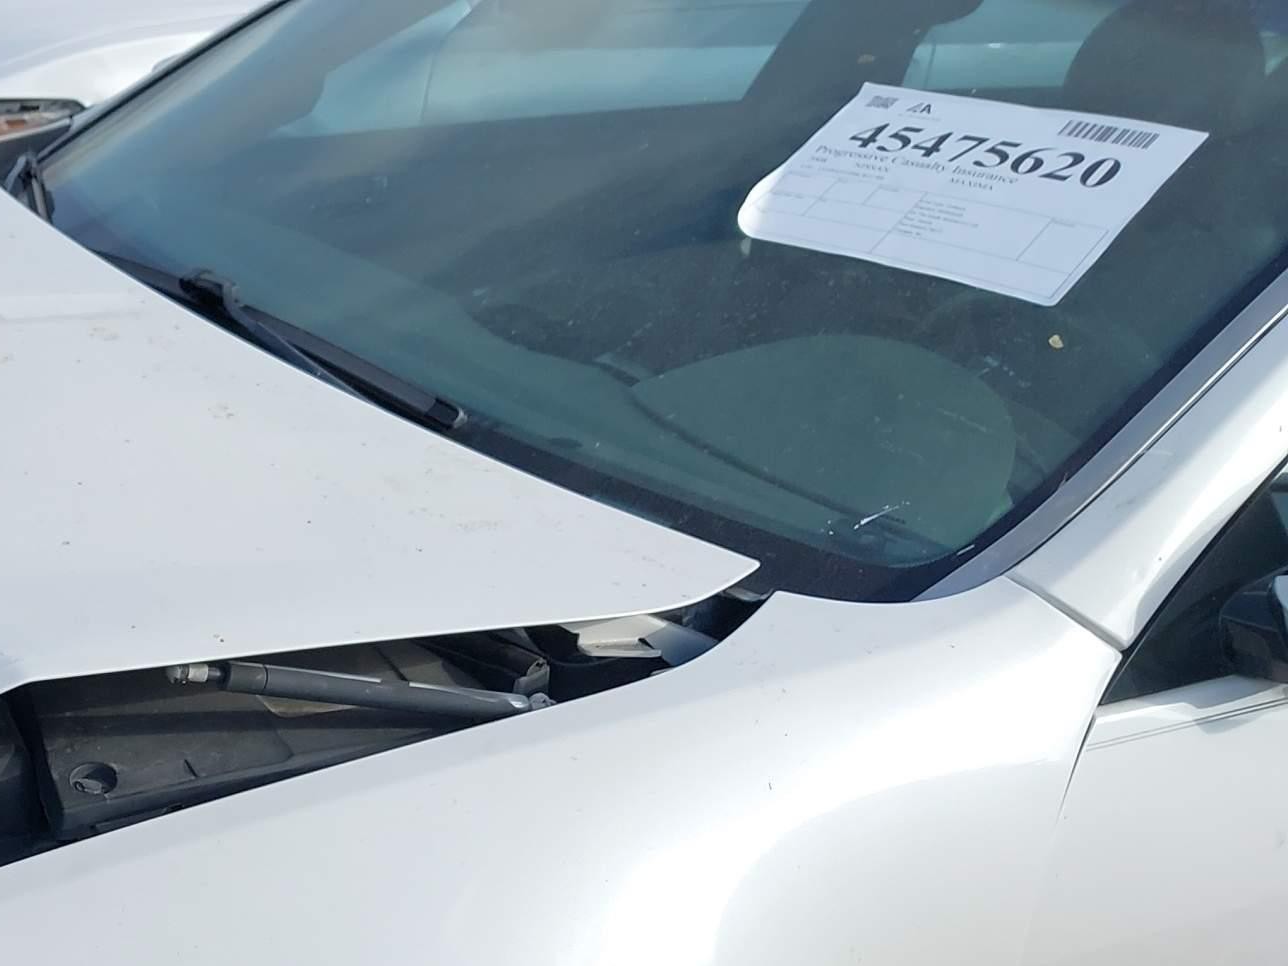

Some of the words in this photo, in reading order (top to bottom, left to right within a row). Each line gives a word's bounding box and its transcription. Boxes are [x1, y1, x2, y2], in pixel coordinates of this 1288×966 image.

[815, 145, 889, 162] Progressive
[891, 157, 945, 174] Casualty
[951, 165, 1019, 184] Insurance
[849, 122, 1120, 188] 45475620
